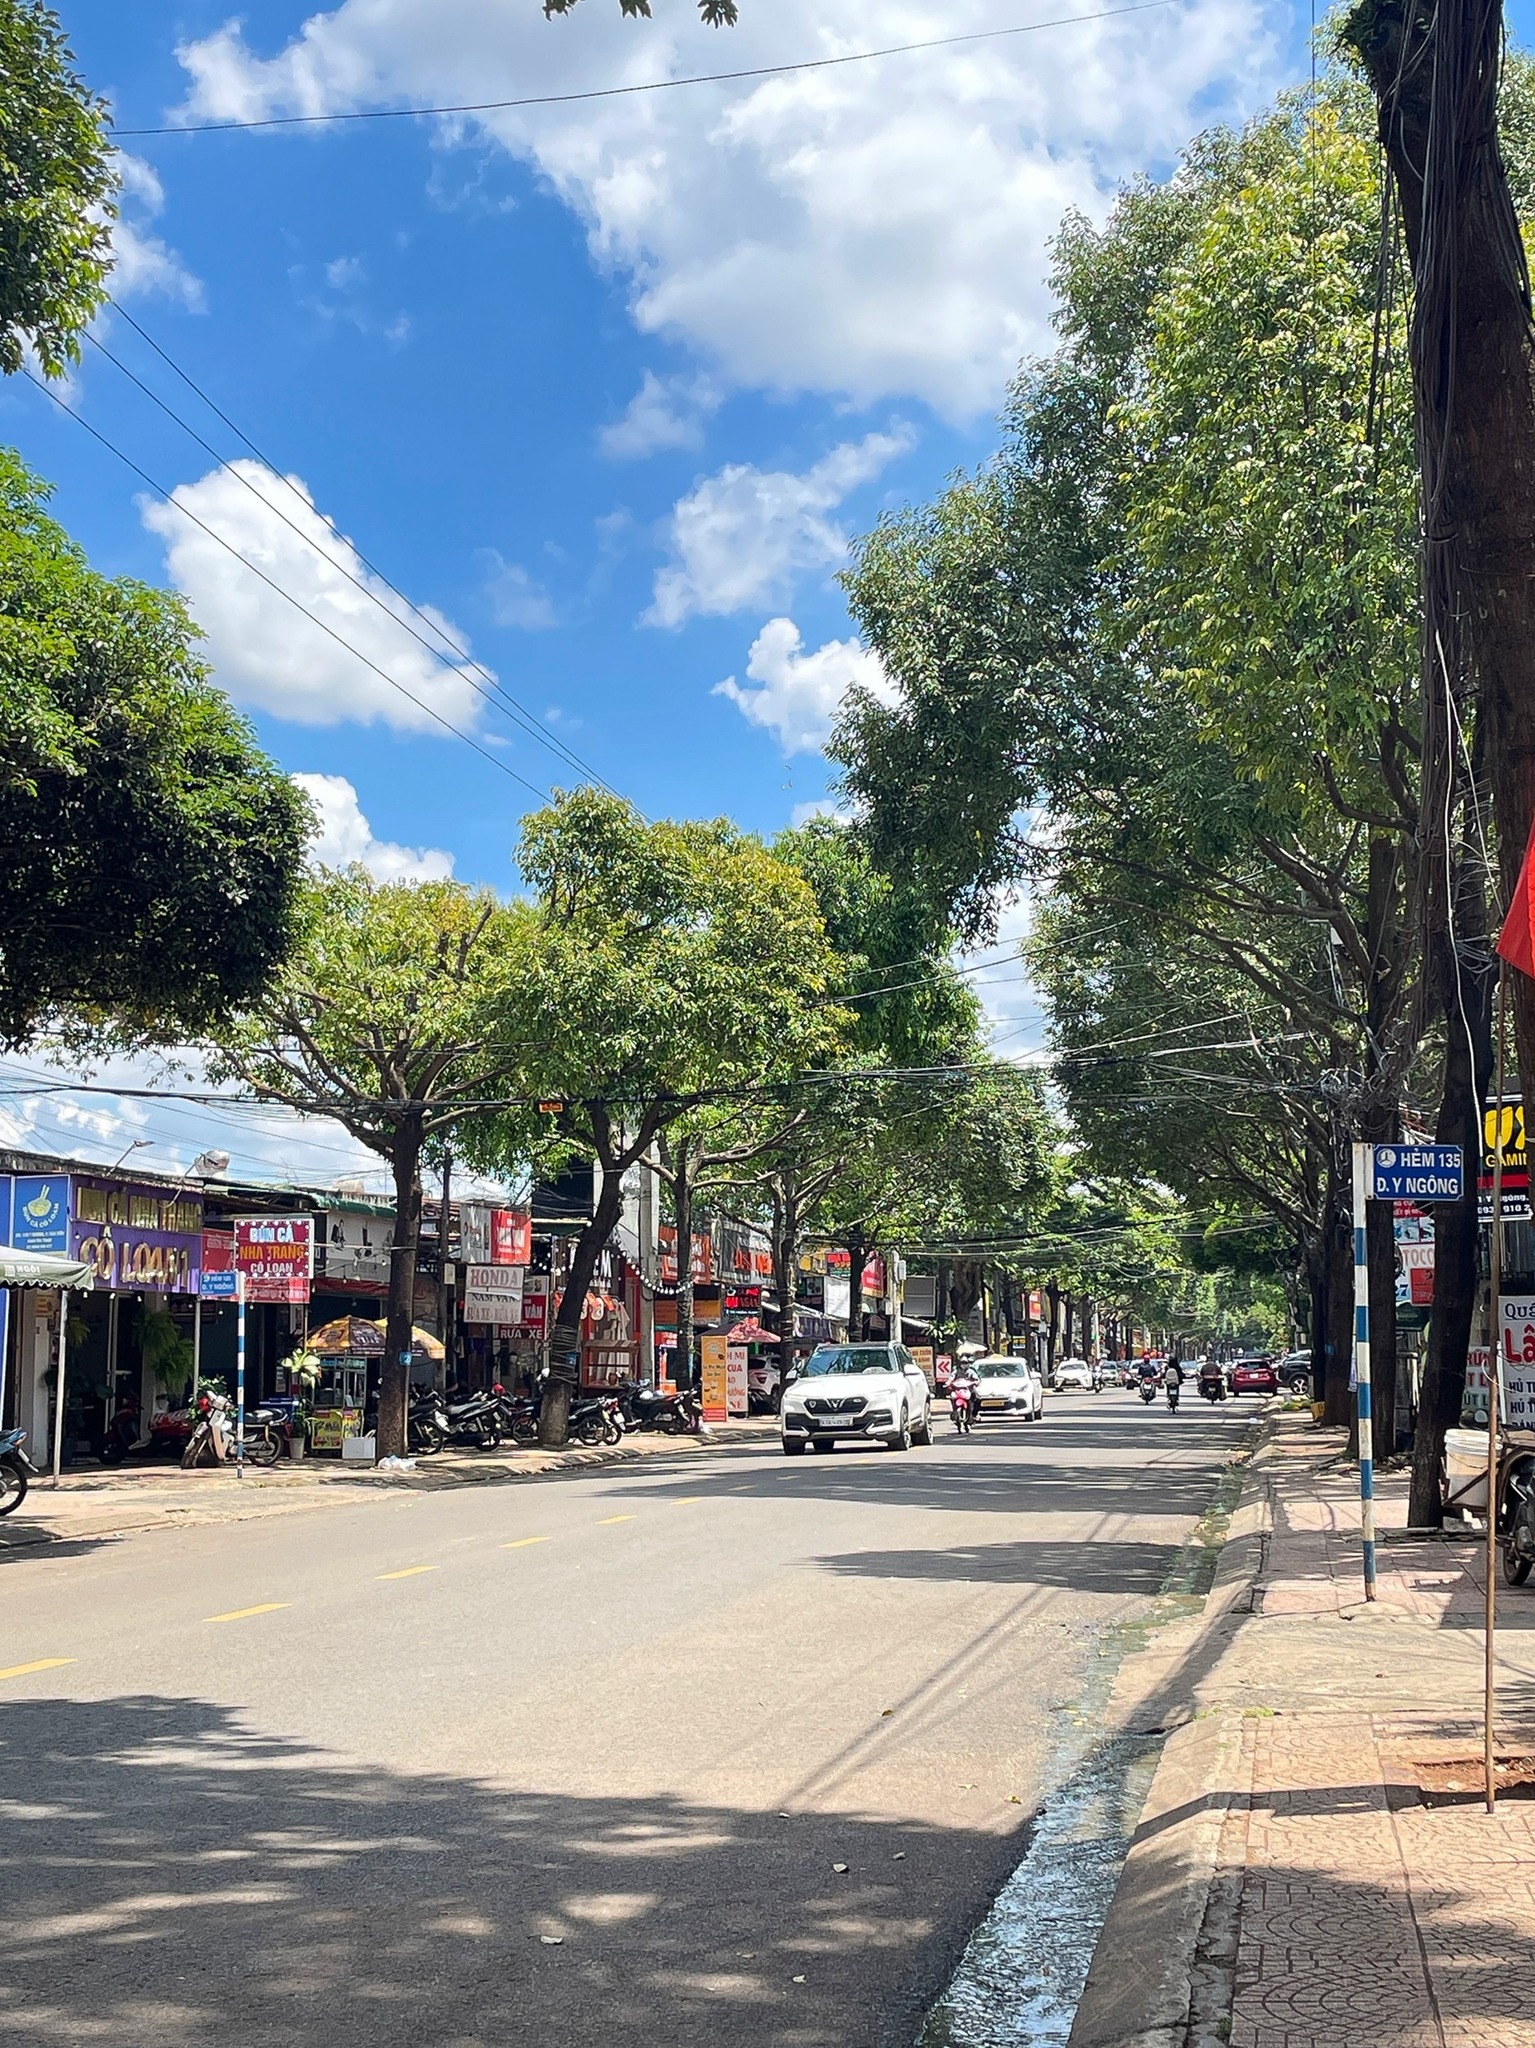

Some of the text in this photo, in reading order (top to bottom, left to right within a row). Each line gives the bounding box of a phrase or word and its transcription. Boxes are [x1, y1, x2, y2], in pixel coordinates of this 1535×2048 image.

[1400, 1148, 1461, 1168] HẺM 135
[1377, 1174, 1459, 1195] Đ. Y NGÔNG
[240, 1246, 264, 1260] NHA
[266, 1246, 304, 1260] TRANG
[251, 1261, 293, 1273] CÔ LOAN
[471, 1269, 519, 1287] HONDA
[529, 1330, 542, 1339] XE
